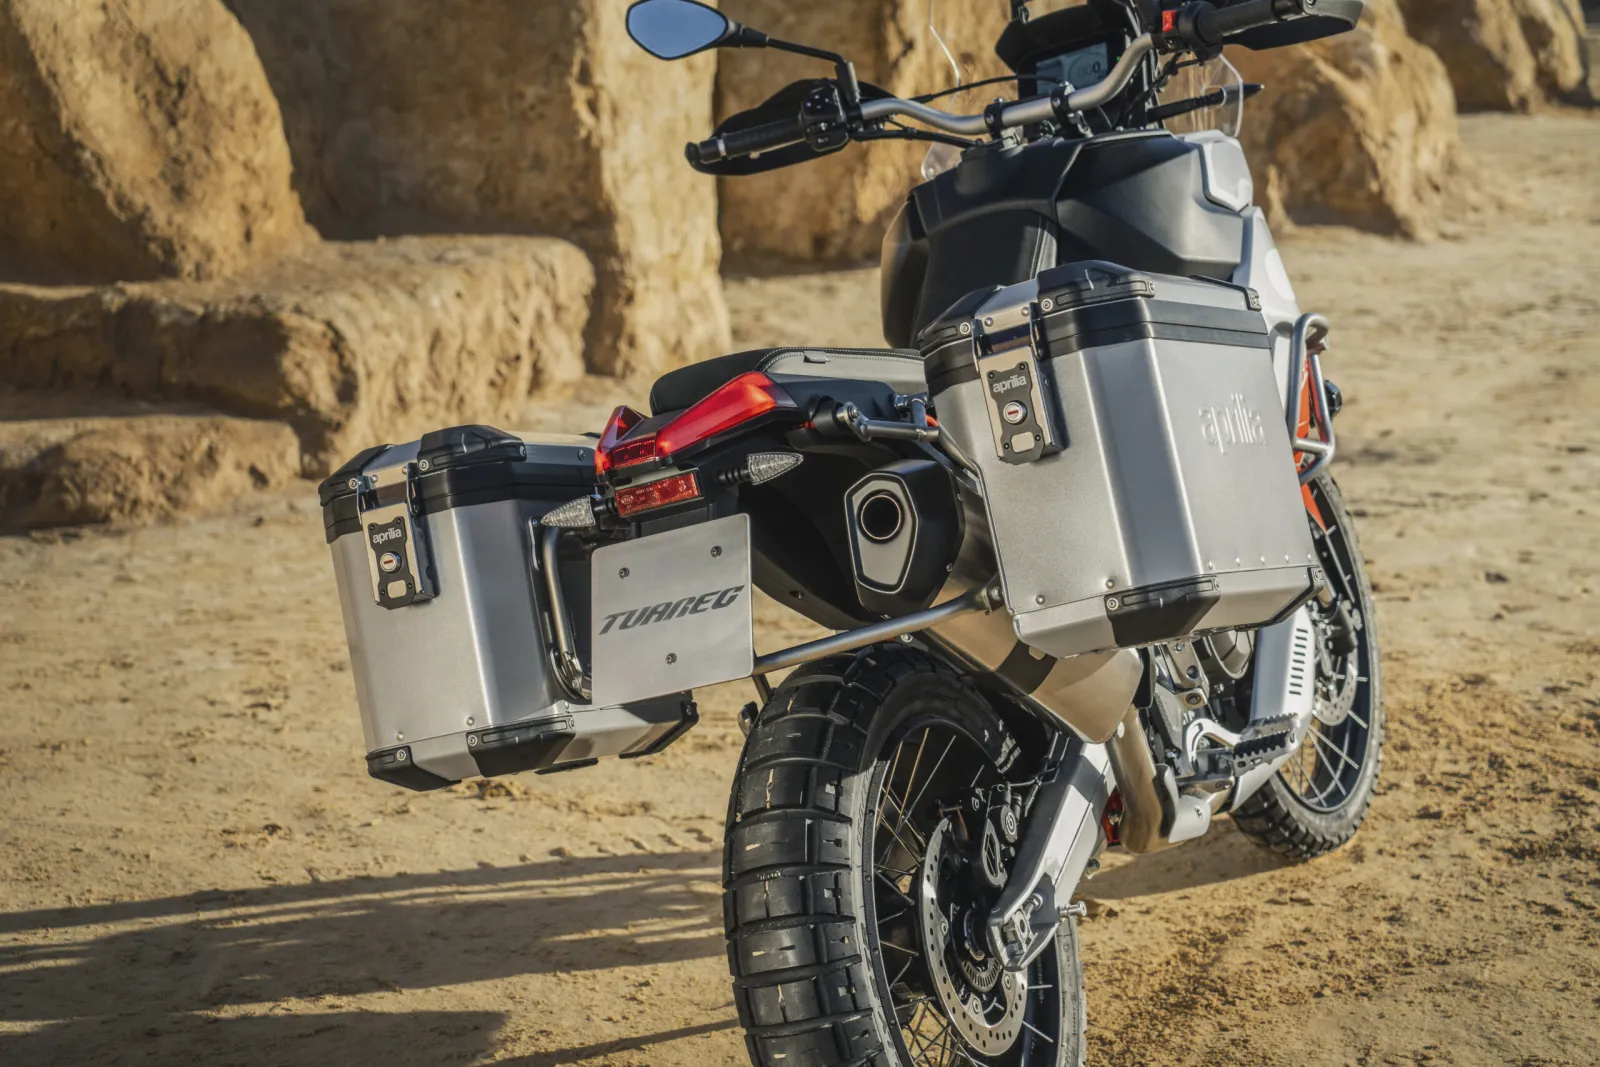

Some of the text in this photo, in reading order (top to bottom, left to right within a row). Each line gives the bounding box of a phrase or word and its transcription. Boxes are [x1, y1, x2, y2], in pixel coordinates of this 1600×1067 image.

[993, 374, 1027, 393] aprilia
[1198, 393, 1266, 454] aprilia
[372, 527, 402, 544] aprilia
[598, 585, 745, 635] TUAREG
